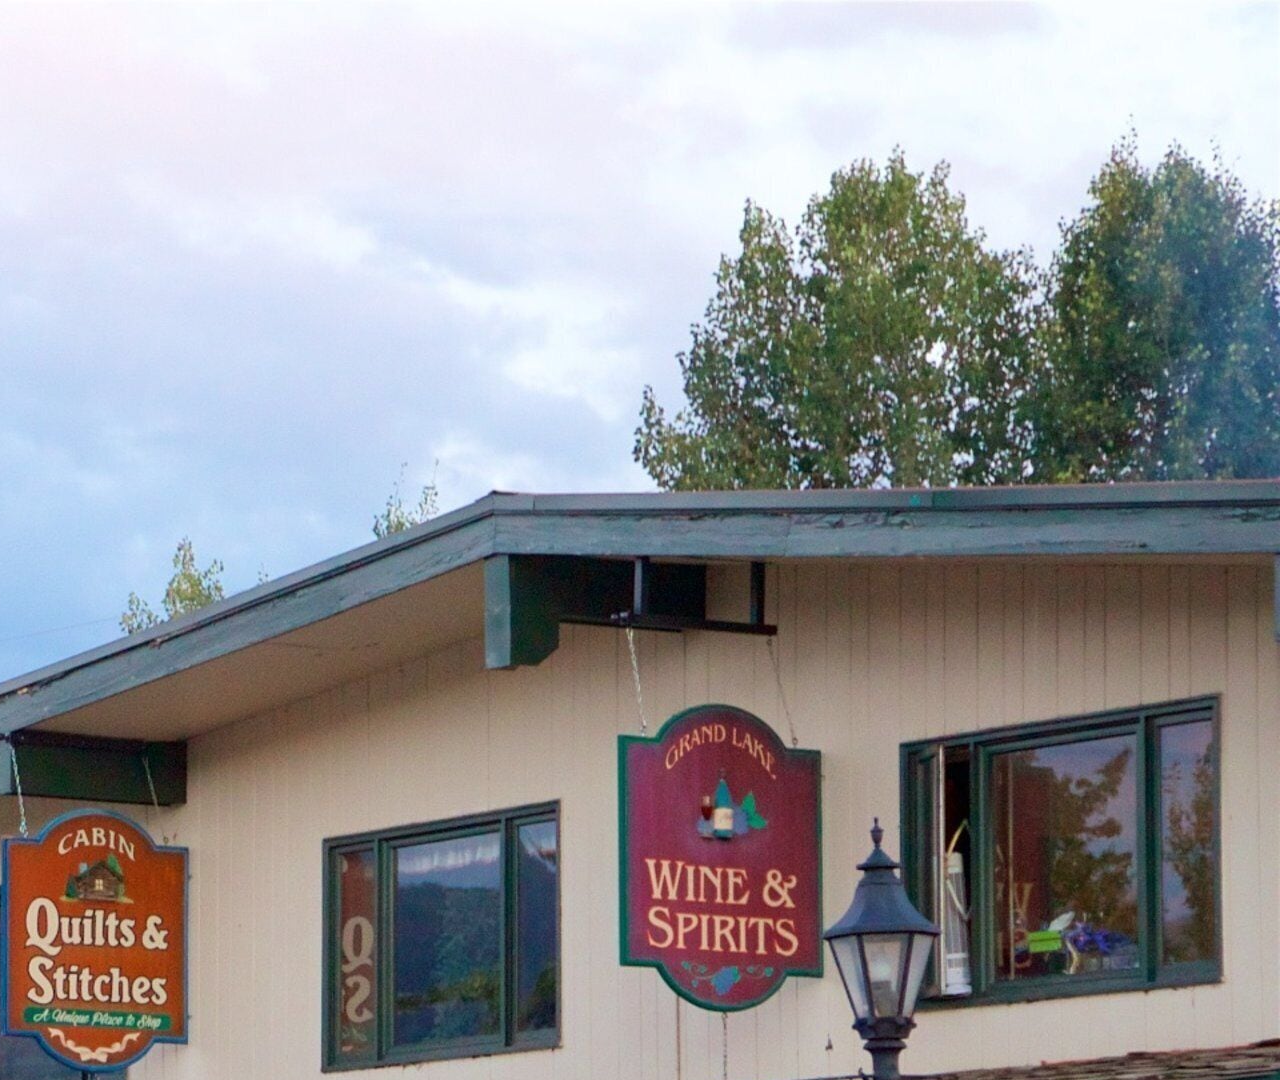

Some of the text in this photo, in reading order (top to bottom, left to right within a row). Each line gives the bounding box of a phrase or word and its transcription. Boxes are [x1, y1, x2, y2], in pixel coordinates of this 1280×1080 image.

[664, 723, 777, 780] GRAND LAKE
[57, 827, 136, 861] CABIN
[645, 858, 798, 908] WINE &
[25, 897, 168, 956] Quilts &
[647, 905, 799, 956] SPIRITS
[26, 955, 168, 1006] Stitches
[33, 1008, 162, 1030] A Unique Place to Shop
